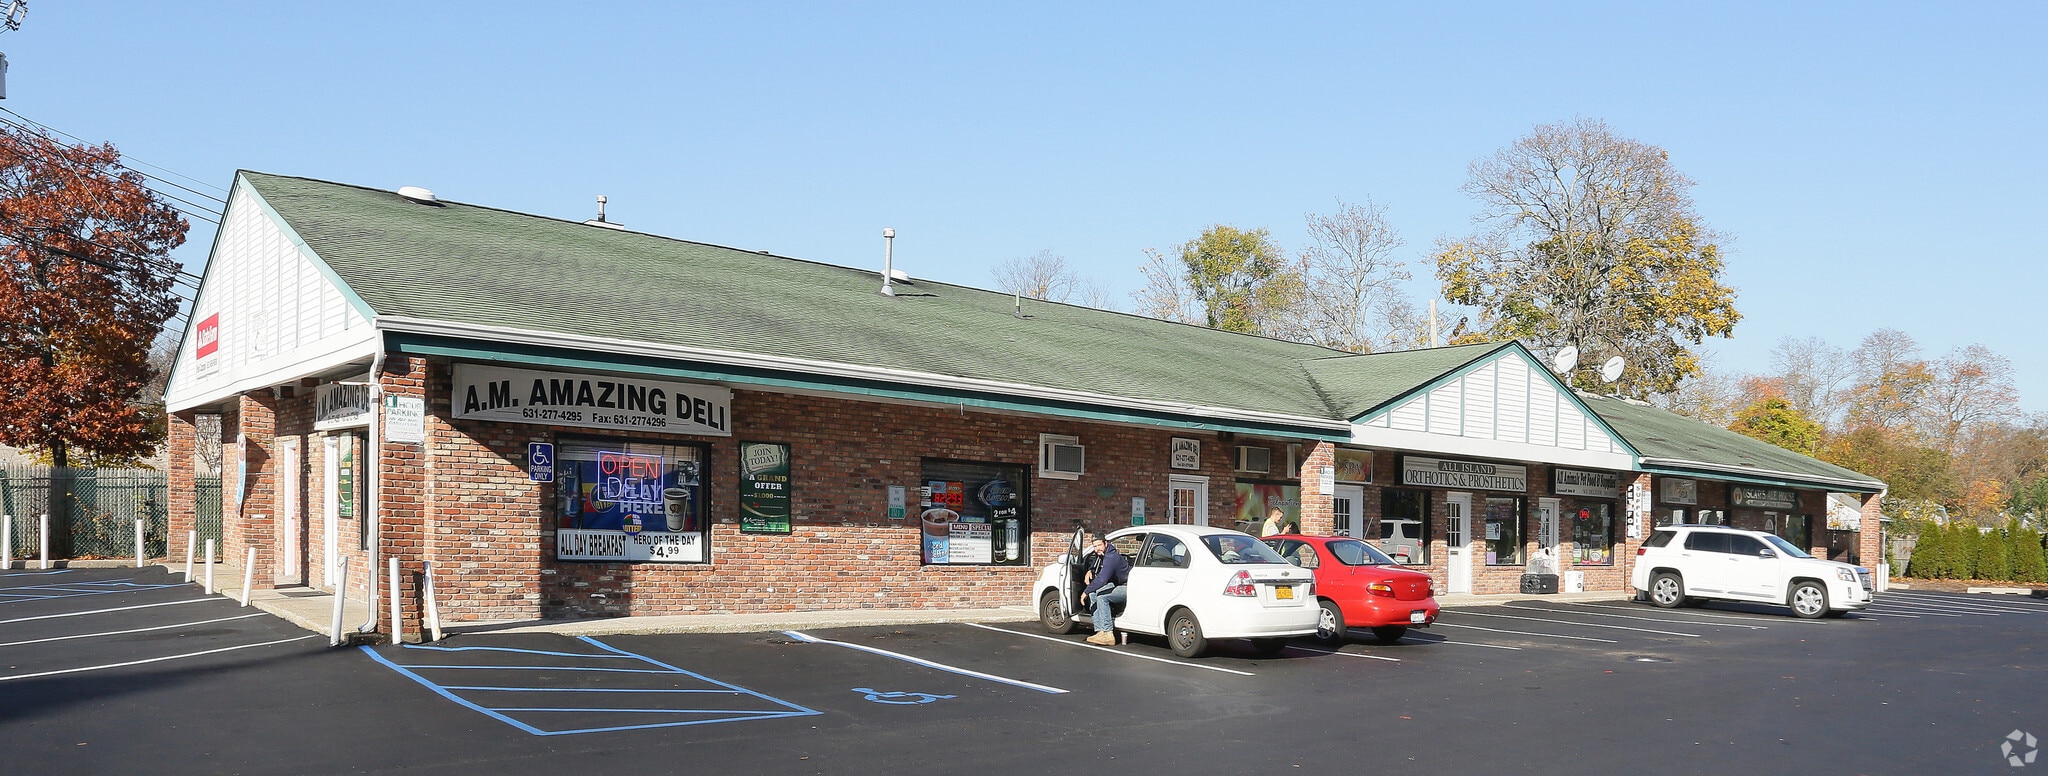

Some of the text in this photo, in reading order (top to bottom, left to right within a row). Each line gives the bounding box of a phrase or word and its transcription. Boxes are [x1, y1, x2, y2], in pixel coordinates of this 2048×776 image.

[399, 402, 422, 410] HOUR
[464, 379, 725, 431] A.M. AMAZING DELI
[386, 409, 421, 418] PARKING
[522, 408, 667, 427] 631-277-4295 Fax: 631-2774296
[753, 447, 772, 457] JOIN
[749, 454, 778, 466] TODAY!
[531, 465, 552, 474] PARKING
[601, 454, 659, 479] OPEN
[1344, 461, 1361, 477] SPA
[1442, 462, 1493, 474] ALL ISLAND
[534, 472, 548, 480] ONLY
[1405, 469, 1525, 490] ORTHOTICS & PROSTHETICS
[607, 477, 660, 501] DELI
[754, 482, 782, 490] OFFER
[620, 501, 664, 515] HERE
[993, 509, 999, 518] 2
[561, 534, 627, 557] ALL DAY BREAKFAST
[633, 535, 696, 546] HERO OF THE DAY
[650, 547, 679, 558] $4.99
